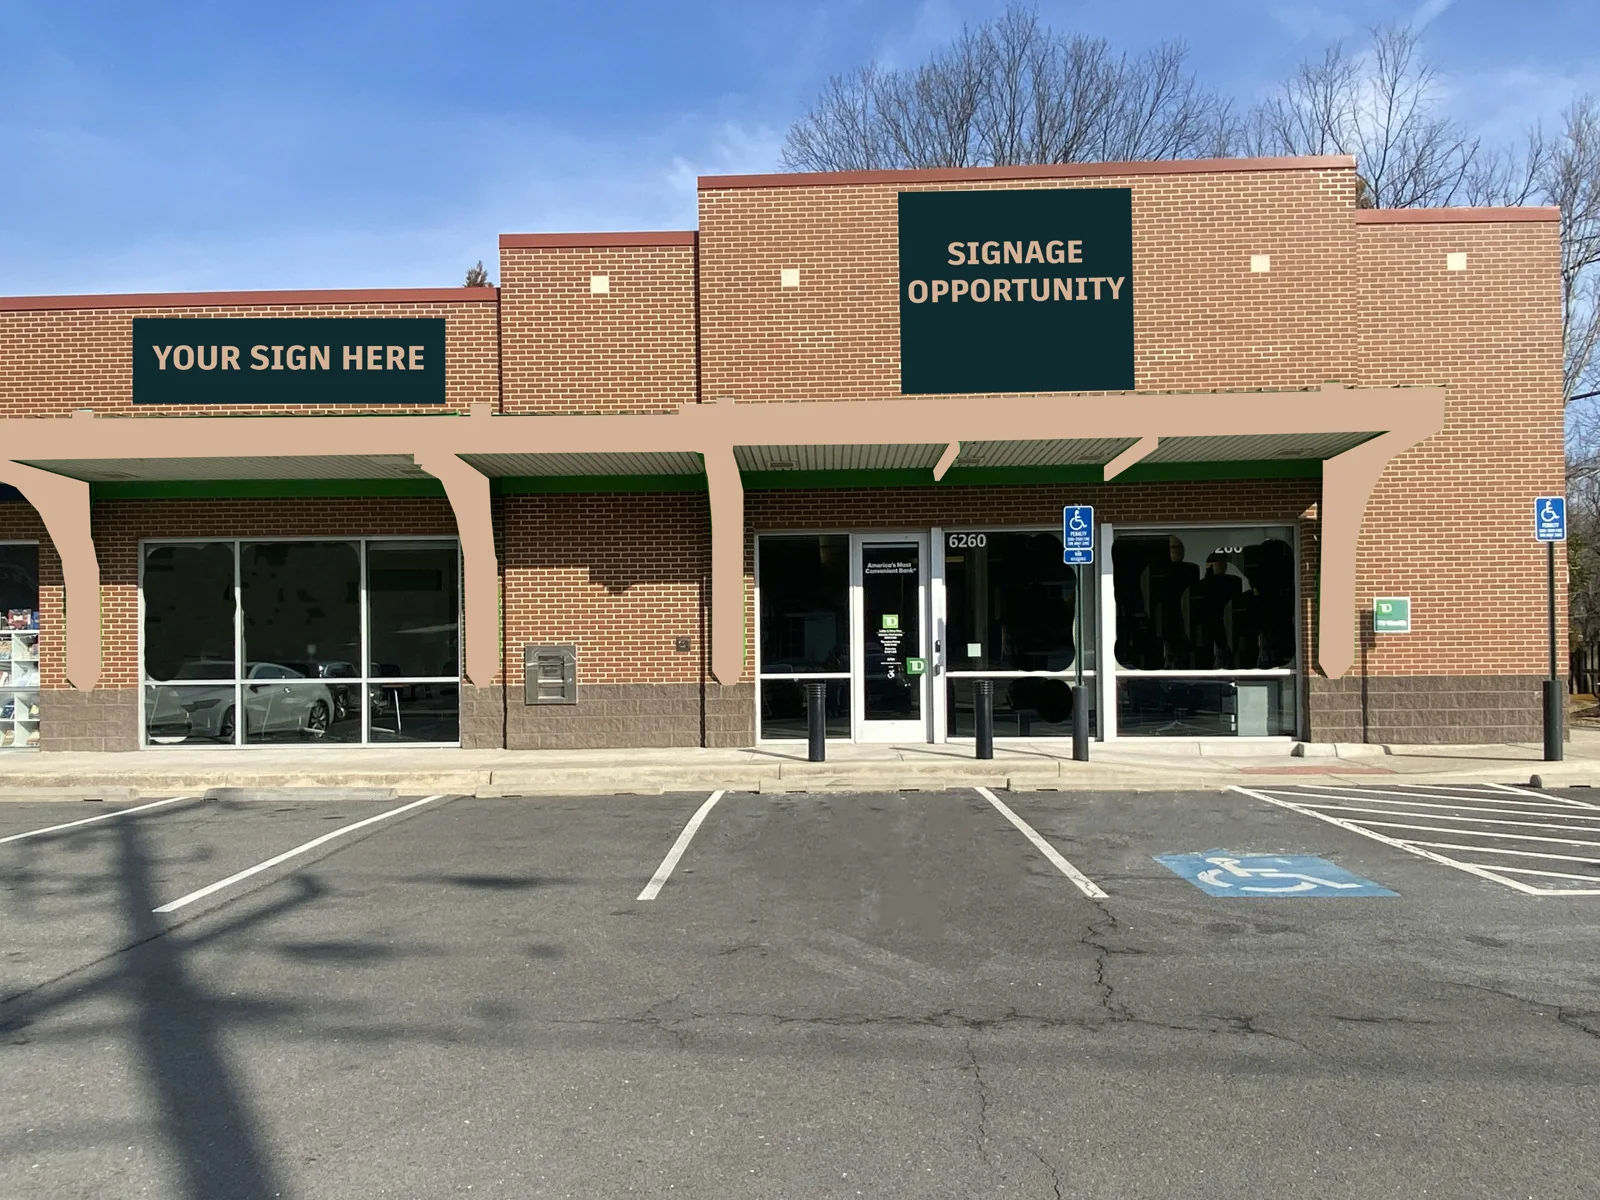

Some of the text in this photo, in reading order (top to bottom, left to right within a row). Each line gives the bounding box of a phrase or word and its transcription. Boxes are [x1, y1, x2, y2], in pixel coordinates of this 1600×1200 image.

[947, 240, 1083, 266] SIGNAGE
[908, 276, 1126, 304] OPPORTUNITY
[152, 344, 425, 371] YOUR SIGN HERE
[949, 534, 987, 548] 6260
[1379, 603, 1392, 613] TD
[884, 616, 898, 626] TD
[909, 660, 924, 672] TD
